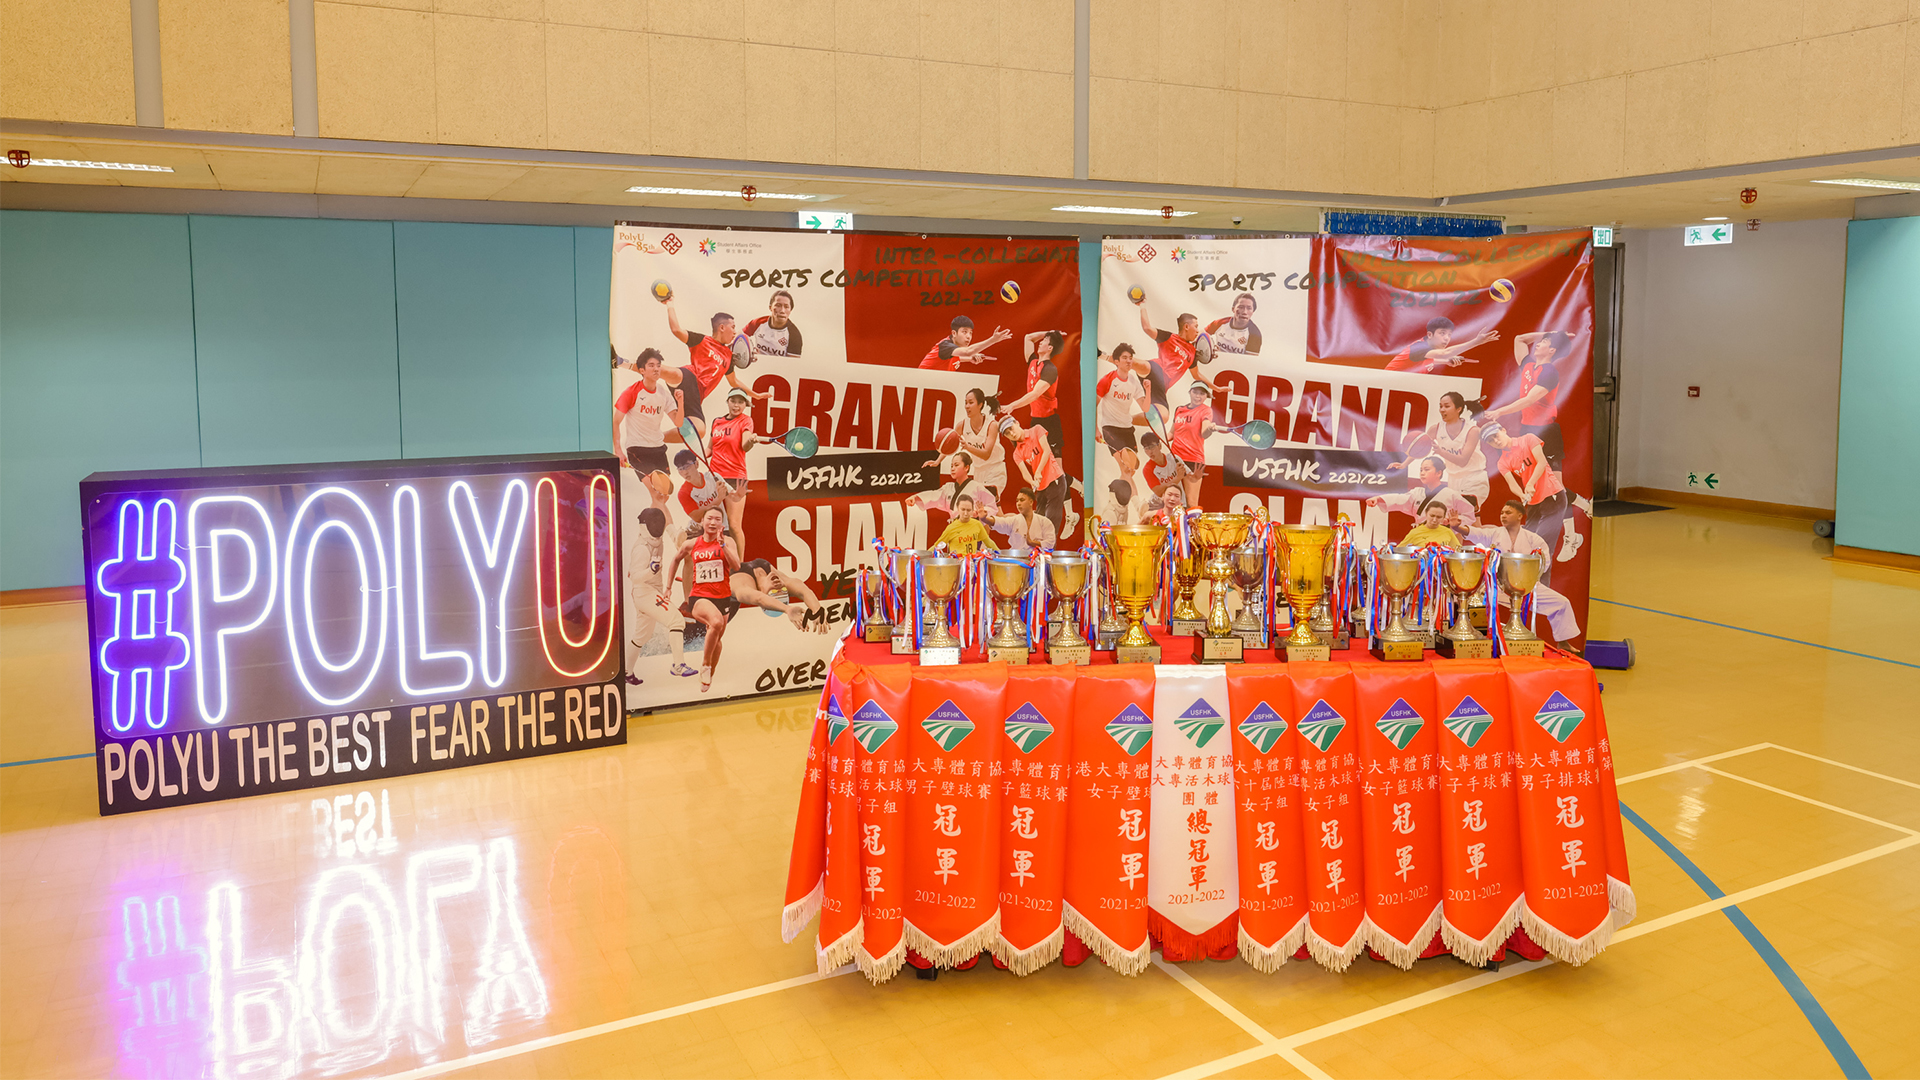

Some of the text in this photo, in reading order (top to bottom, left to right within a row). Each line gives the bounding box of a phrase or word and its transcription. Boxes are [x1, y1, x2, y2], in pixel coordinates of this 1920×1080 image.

[619, 232, 645, 243] PolyU
[1597, 229, 1611, 245] 出口
[636, 241, 656, 254] 85th
[875, 246, 938, 265] INTER
[1103, 245, 1124, 256] PolyU
[1116, 252, 1132, 262] 85th
[1341, 250, 1413, 268] INTER
[720, 268, 976, 289] SPORTS COMPETITION
[1188, 270, 1458, 293] SPORTS COMPETITION
[920, 290, 995, 308] 2021-22
[1389, 291, 1483, 308] 2021-22
[1113, 390, 1133, 401] PolyU
[640, 404, 662, 416] PolyU
[751, 374, 957, 452] GRAND
[1211, 369, 1429, 452] GRAND
[786, 465, 923, 490] USFHK 2021/22
[1242, 457, 1388, 485] USFHK 2021/22
[775, 500, 928, 582] SLAM
[693, 549, 722, 561] PolyU
[699, 568, 720, 580] 411
[97, 474, 614, 732] #POLYU
[860, 711, 883, 719] USFHK
[1190, 708, 1212, 716] USFHK
[1312, 710, 1332, 719] USFHK
[1390, 709, 1412, 717] USFHK
[1459, 706, 1480, 714] USFHK
[1548, 702, 1569, 710] USFHK
[1016, 713, 1039, 721] USFHK
[1253, 713, 1274, 721] USFHK
[104, 683, 622, 805] POLYU THE BEST FEAR THE RED
[912, 757, 1002, 777] 大專體育協
[1155, 754, 1234, 770] 大專體育協
[1235, 756, 1295, 774] 大專體育
[1300, 752, 1355, 774] 專體育協
[1368, 753, 1432, 774] 大專體育
[906, 778, 992, 800] 男子壁球賽
[1152, 771, 1231, 788] 大專活木球
[1361, 774, 1438, 797] 女子籃球賽
[1001, 781, 1068, 802] 子籃球賽
[1182, 790, 1219, 806] 團體
[1241, 795, 1288, 812] 女子組
[1304, 792, 1349, 812] 女子組
[932, 803, 962, 886] 冠軍
[1010, 804, 1038, 888] 冠軍
[1391, 801, 1416, 883] 冠軍
[1462, 799, 1488, 881] 冠軍
[1555, 795, 1587, 879] 冠軍
[1117, 808, 1146, 891] 冠軍
[1186, 808, 1212, 892] 總冠軍
[1255, 821, 1280, 896] 冠軍
[1320, 819, 1346, 895] 冠軍
[862, 822, 886, 903] 冠軍
[914, 889, 977, 909] 2021-2022
[1168, 889, 1225, 905] 2021-2022
[1377, 885, 1429, 906] 2021-2022
[1448, 882, 1502, 902] 2021-2022
[1543, 883, 1605, 900] 2021-2022
[1240, 895, 1294, 912] 2021-2022
[1310, 892, 1360, 913] 2021-2022
